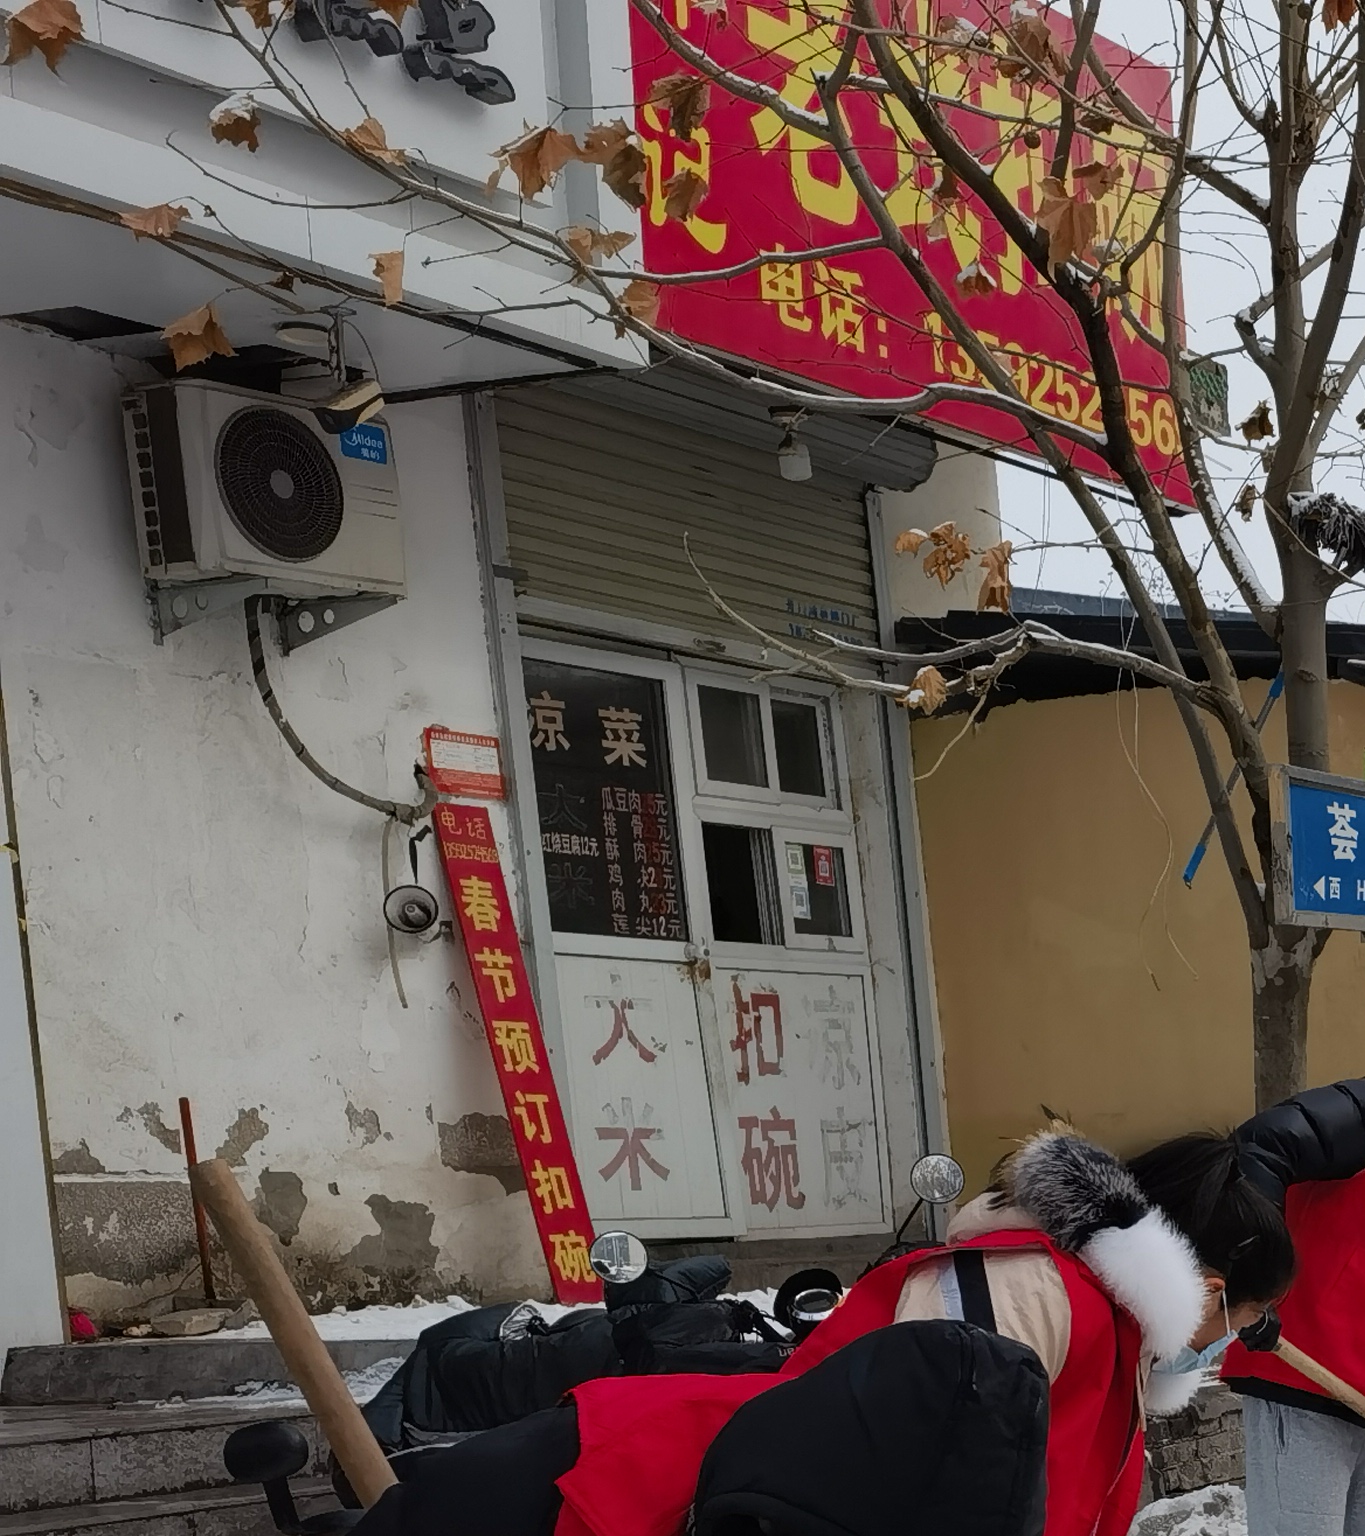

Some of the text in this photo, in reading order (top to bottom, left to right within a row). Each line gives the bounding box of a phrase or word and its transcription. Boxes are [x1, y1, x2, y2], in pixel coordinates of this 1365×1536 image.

[441, 806, 487, 840] 电话
[1328, 876, 1341, 900] 西
[459, 875, 597, 1283] 春节预订扣碗
[729, 974, 806, 1212] 扣碗
